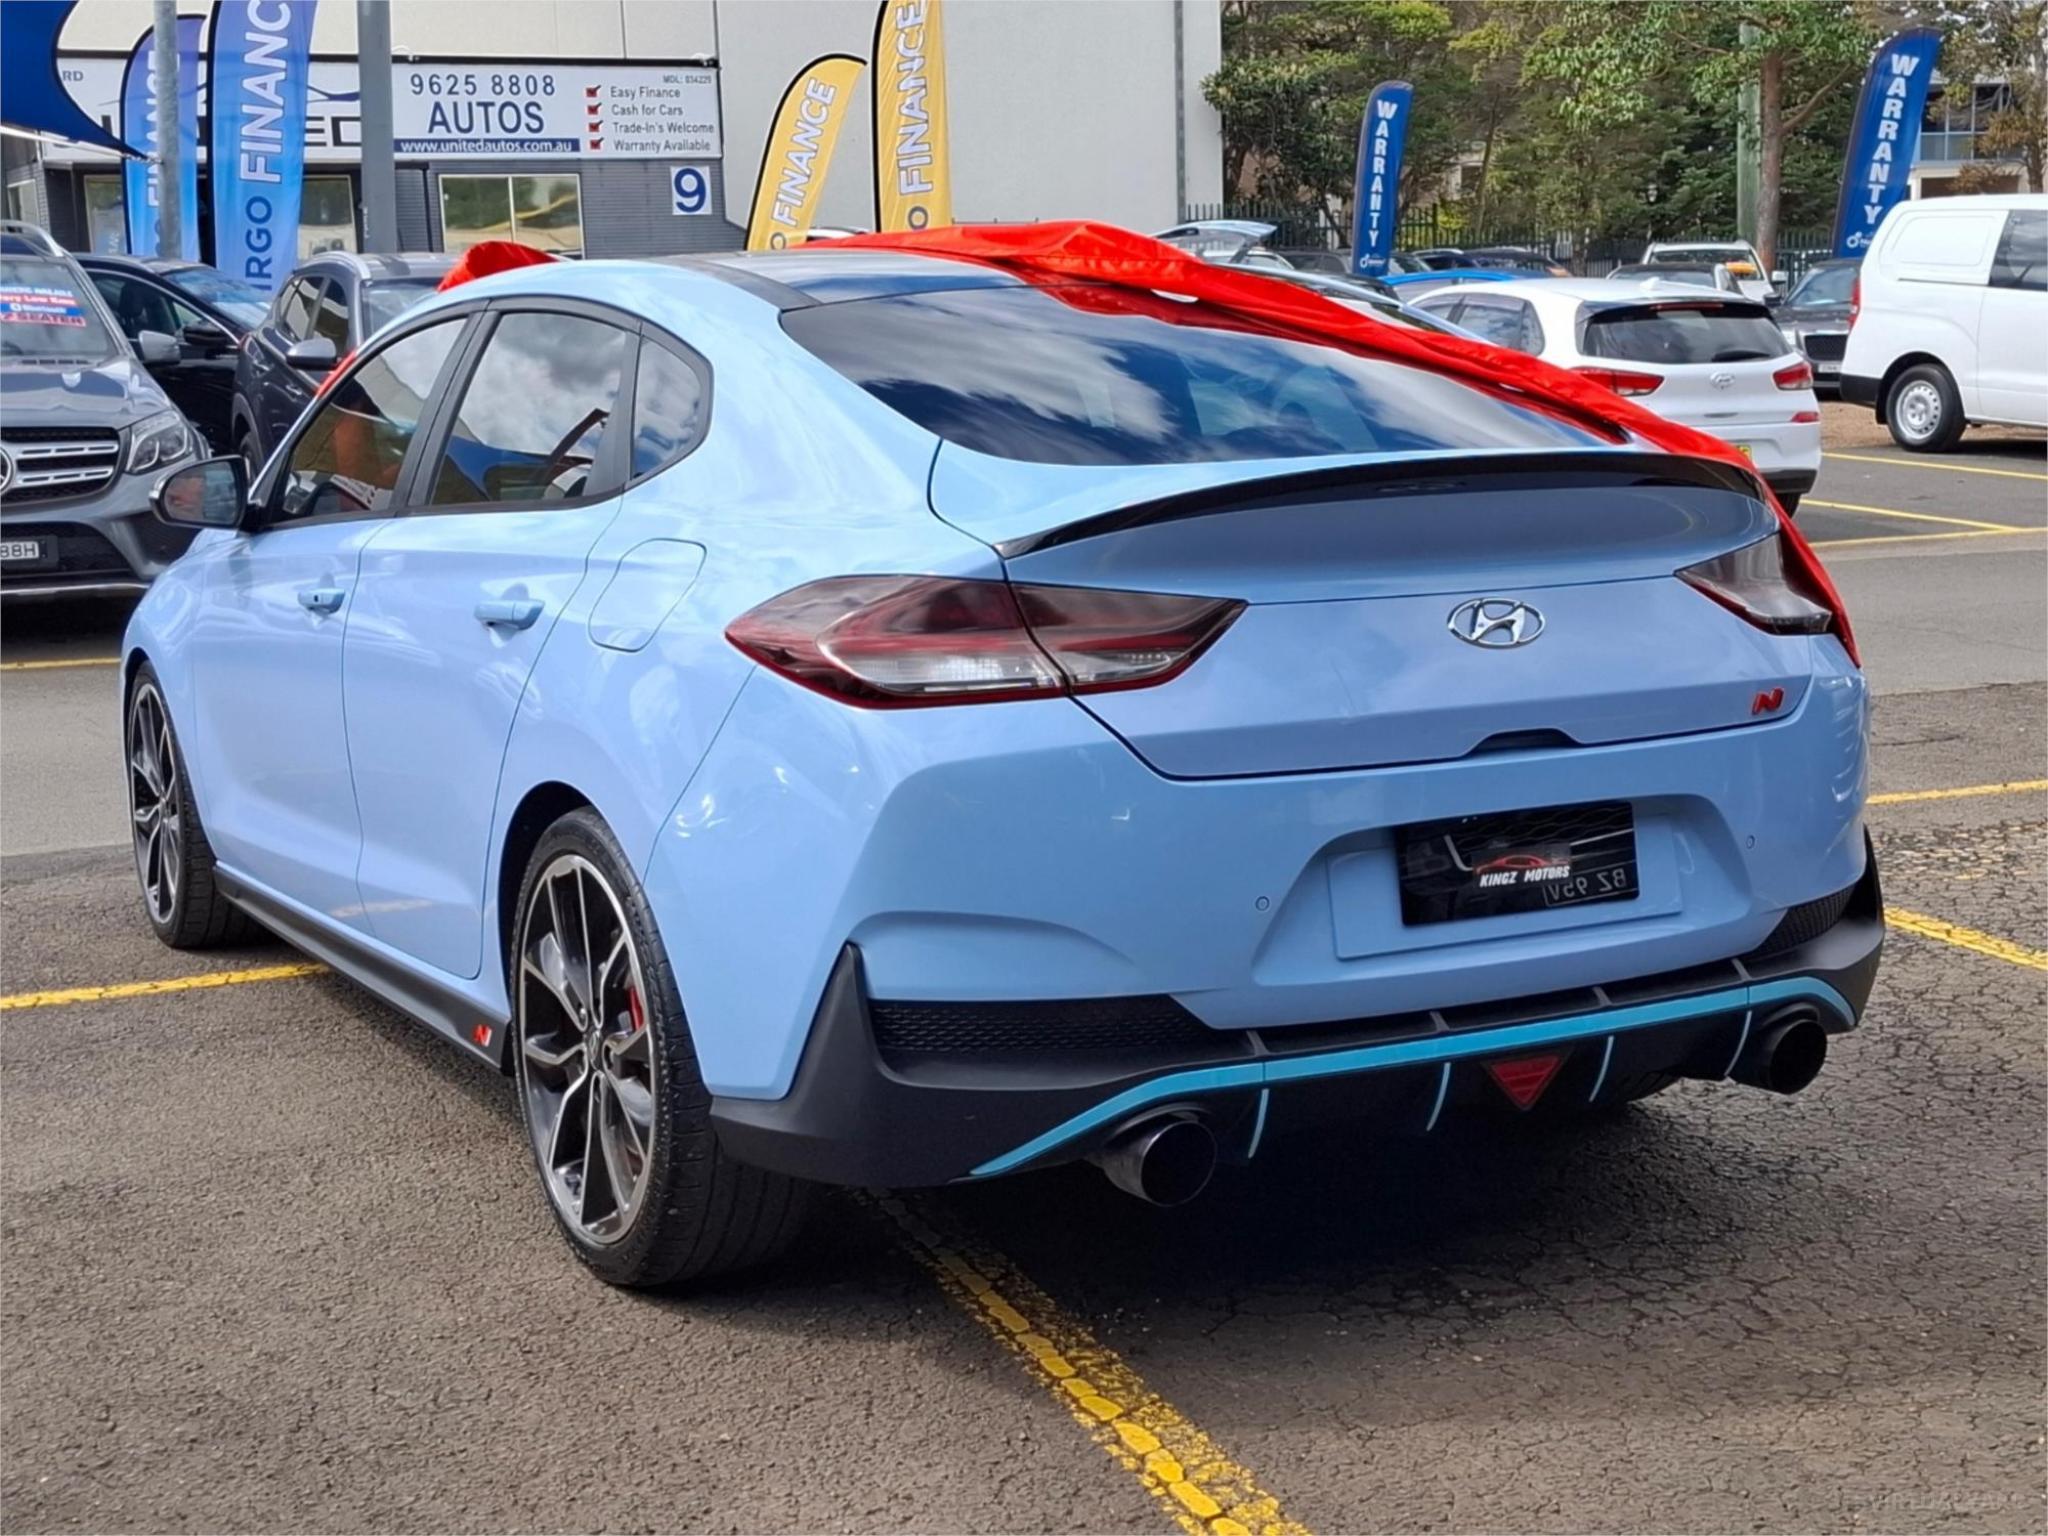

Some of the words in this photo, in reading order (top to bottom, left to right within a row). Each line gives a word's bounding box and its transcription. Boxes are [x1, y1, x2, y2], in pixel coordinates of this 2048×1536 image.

[62, 70, 84, 82] RD
[410, 73, 477, 96] 9625
[491, 74, 555, 96] 8808
[610, 86, 636, 100] Easy
[639, 86, 681, 98] Finance
[895, 0, 933, 195] FINANCE
[428, 101, 545, 134] AUTOS
[611, 104, 639, 116] Cash
[641, 104, 656, 115] for
[659, 104, 684, 116] Cars
[613, 121, 665, 133] Trade-In's
[667, 123, 714, 134] Welcome
[1862, 53, 1920, 225] WARRANTY
[400, 139, 572, 153] www.unitedautos.com.au
[613, 139, 661, 153] Warranty
[663, 140, 711, 151] Available
[771, 78, 837, 227] FINANCE
[1369, 99, 1399, 247] WARRANTY
[674, 167, 707, 213] 9
[1479, 871, 1518, 888] KINGZ
[1524, 865, 1570, 883] MOTORS
